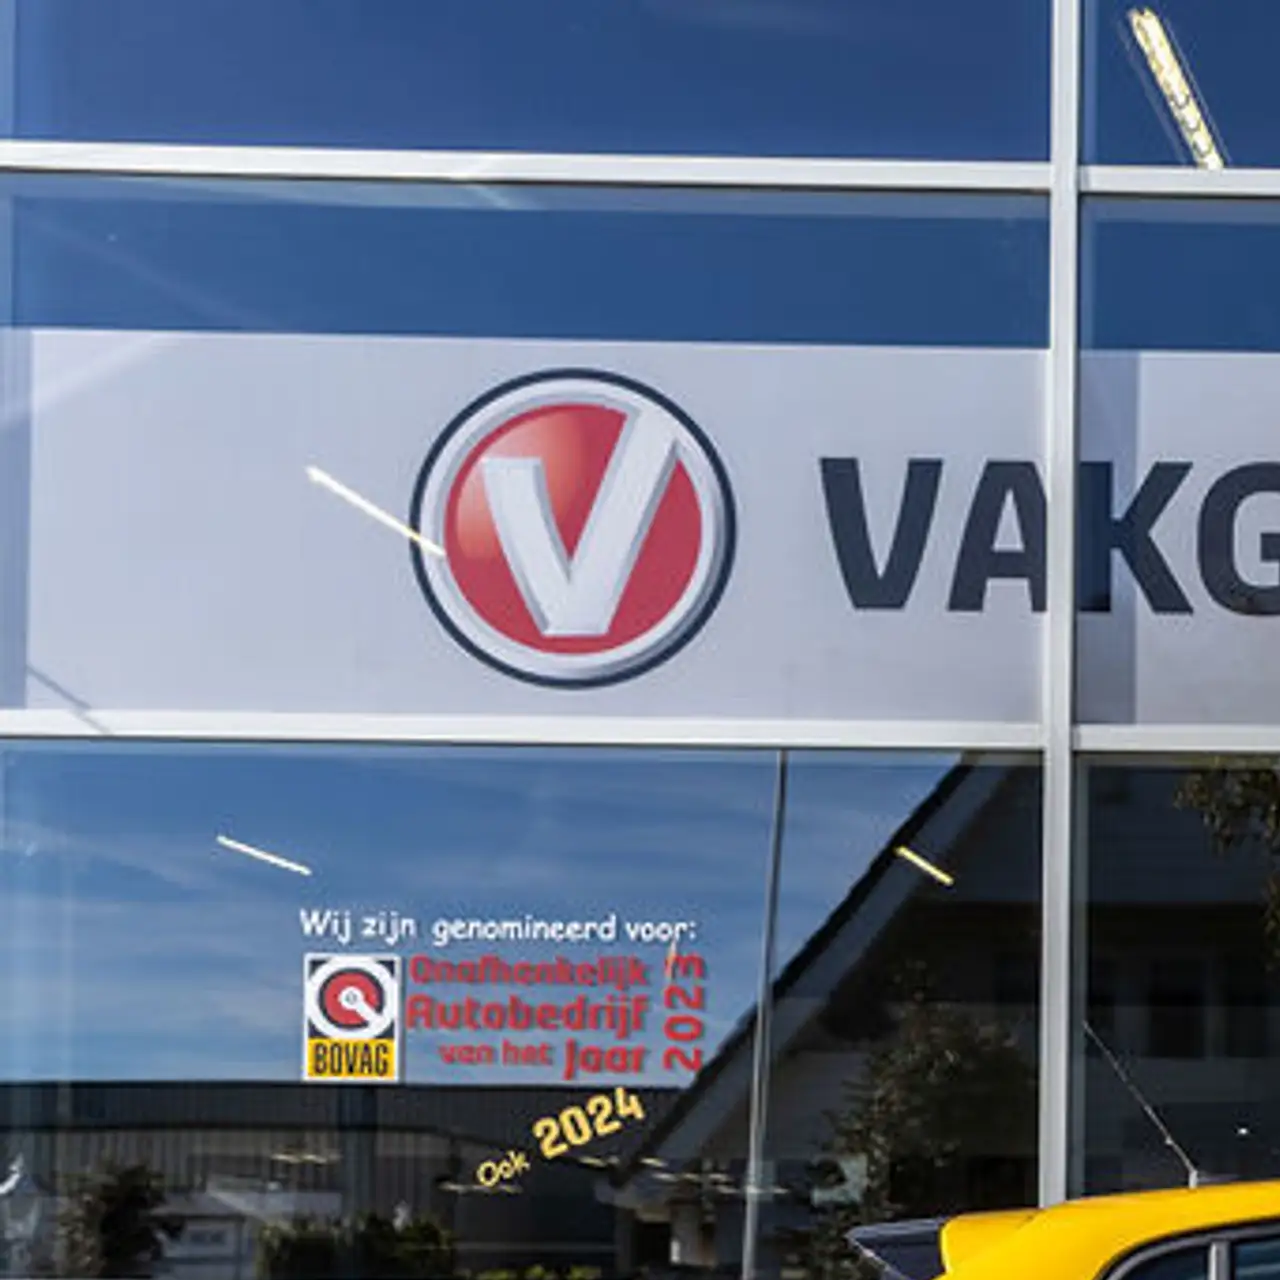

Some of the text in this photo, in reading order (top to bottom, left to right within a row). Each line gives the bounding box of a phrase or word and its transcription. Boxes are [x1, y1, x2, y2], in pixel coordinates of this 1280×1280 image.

[300, 908, 697, 947] Wij zijn genomineerd voor:
[404, 992, 649, 1040] Autobedrijf
[662, 951, 706, 1072] 2023
[313, 1042, 390, 1077] BOVAG
[438, 1043, 494, 1066] van
[502, 1037, 552, 1067] het
[476, 1086, 647, 1187] Ook 2024
